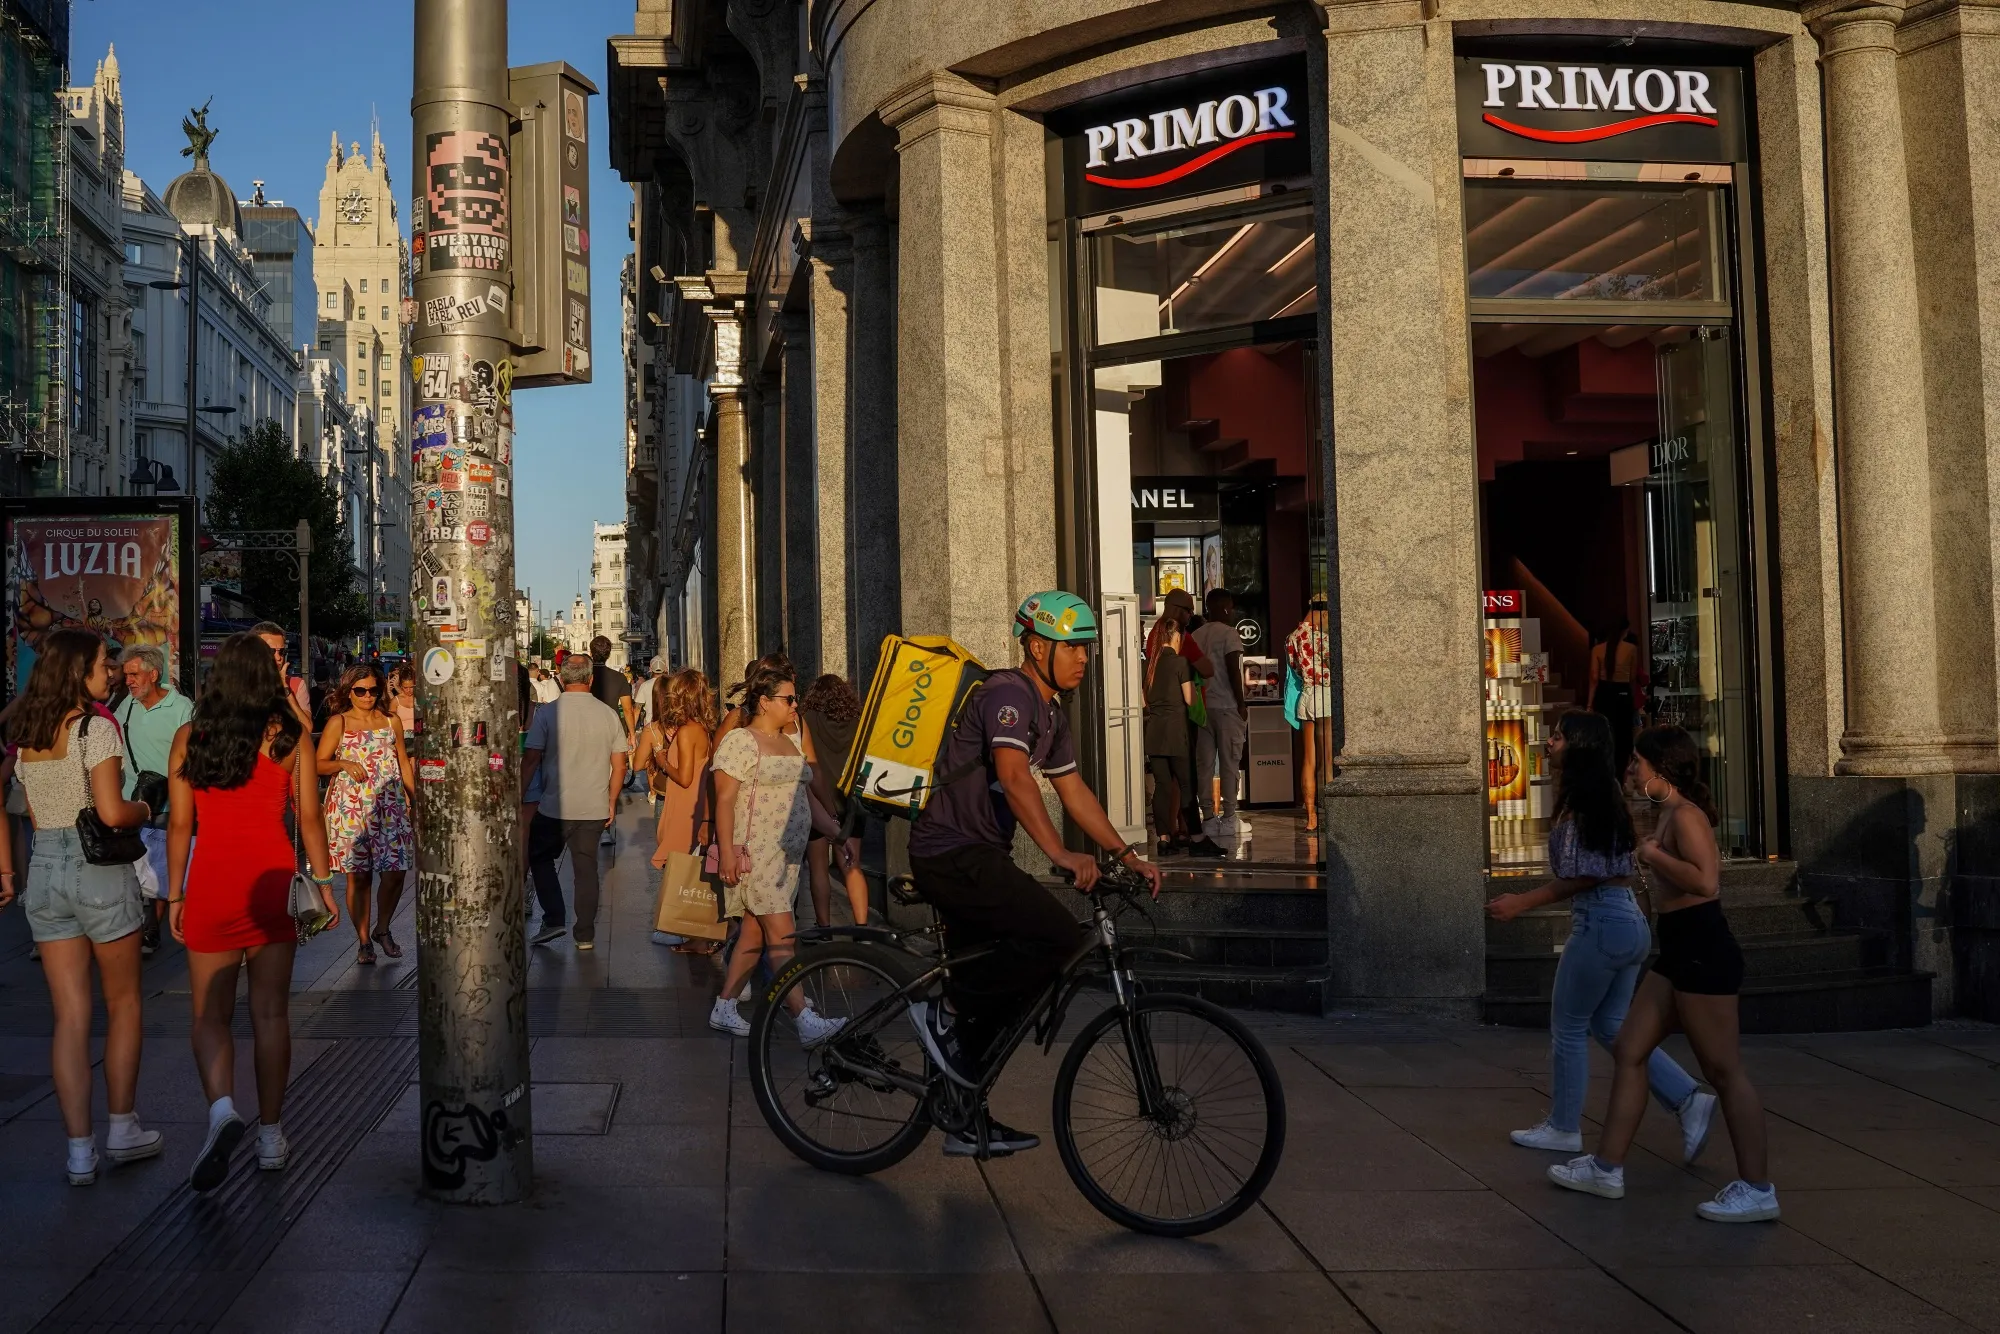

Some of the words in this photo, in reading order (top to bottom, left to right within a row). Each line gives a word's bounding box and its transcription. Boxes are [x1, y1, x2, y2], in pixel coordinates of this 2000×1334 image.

[1481, 63, 1718, 115] PRIMOR
[1084, 86, 1295, 169] PRIMOR
[449, 245, 504, 261] KNOWS
[460, 256, 500, 270] WOLF
[457, 299, 481, 320] REV
[425, 356, 450, 371] TAEM
[424, 370, 448, 398] 54
[1652, 436, 1690, 468] DIOR
[441, 473, 463, 484] HELAS
[45, 528, 84, 540] CIRQUE
[87, 529, 102, 537] DU
[104, 528, 139, 537] SOLEIL
[44, 542, 142, 580] LUZIA
[892, 673, 932, 749] Glovo
[678, 886, 718, 902] lefties
[767, 963, 803, 1003] MAXXIS
